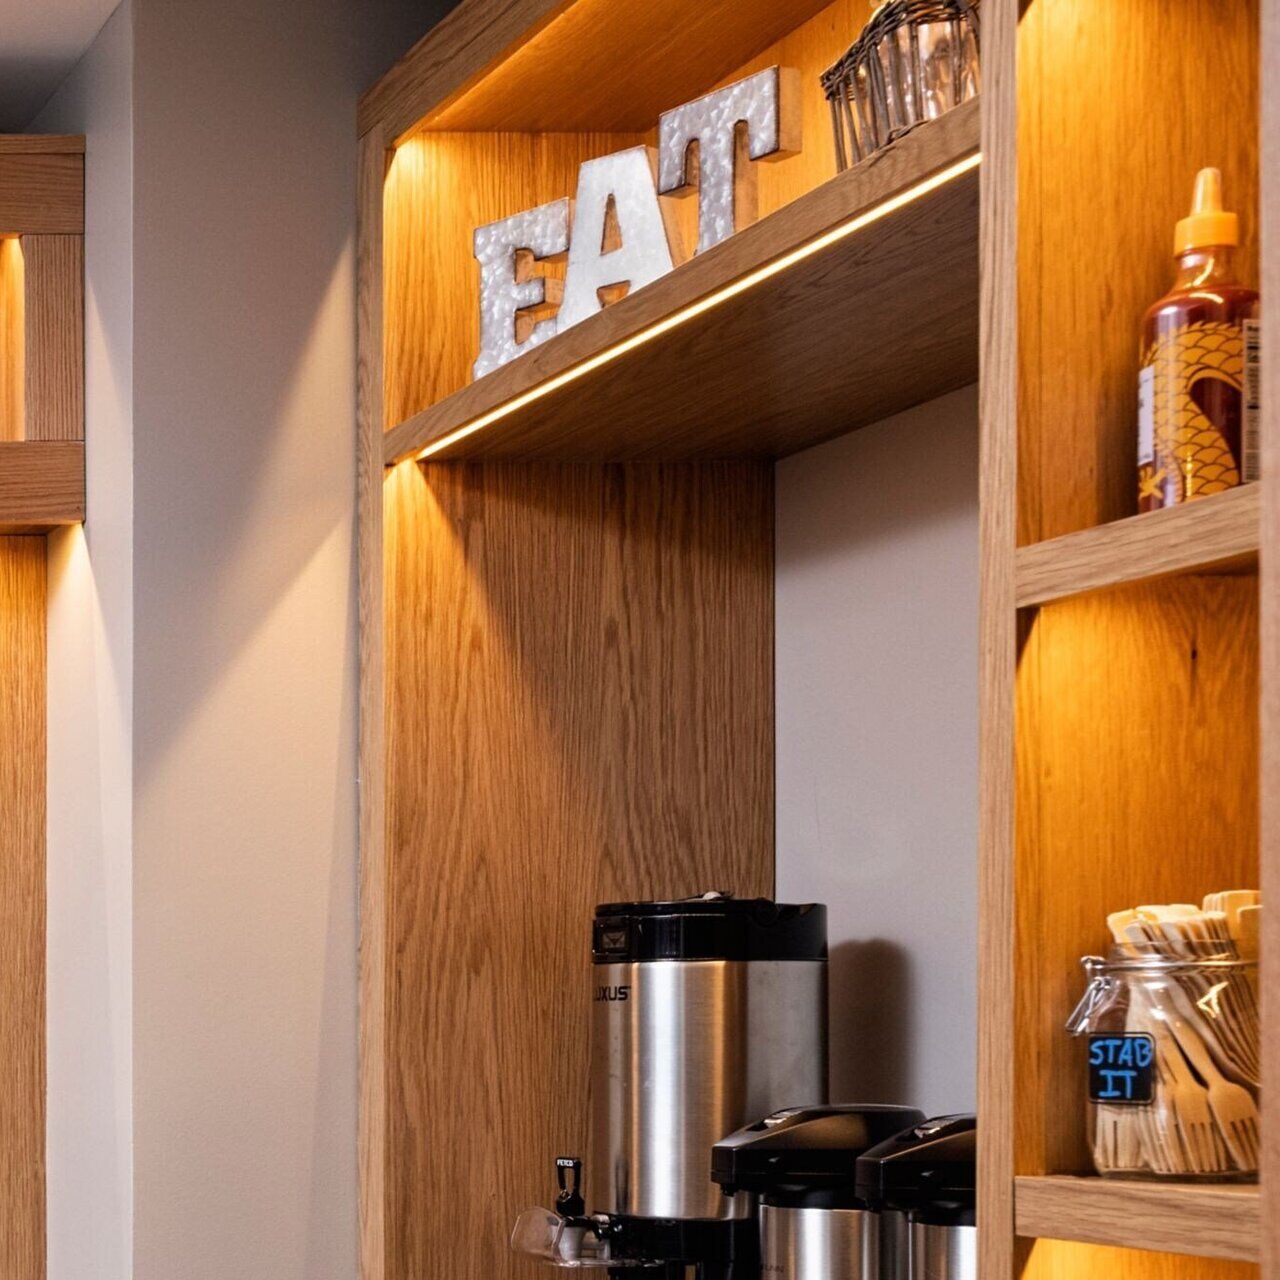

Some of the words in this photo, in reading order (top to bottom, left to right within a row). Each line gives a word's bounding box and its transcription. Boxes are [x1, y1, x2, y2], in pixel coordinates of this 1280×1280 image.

[473, 65, 781, 381] EAT
[1089, 1038, 1153, 1067] STAB
[1098, 1069, 1137, 1099] IT
